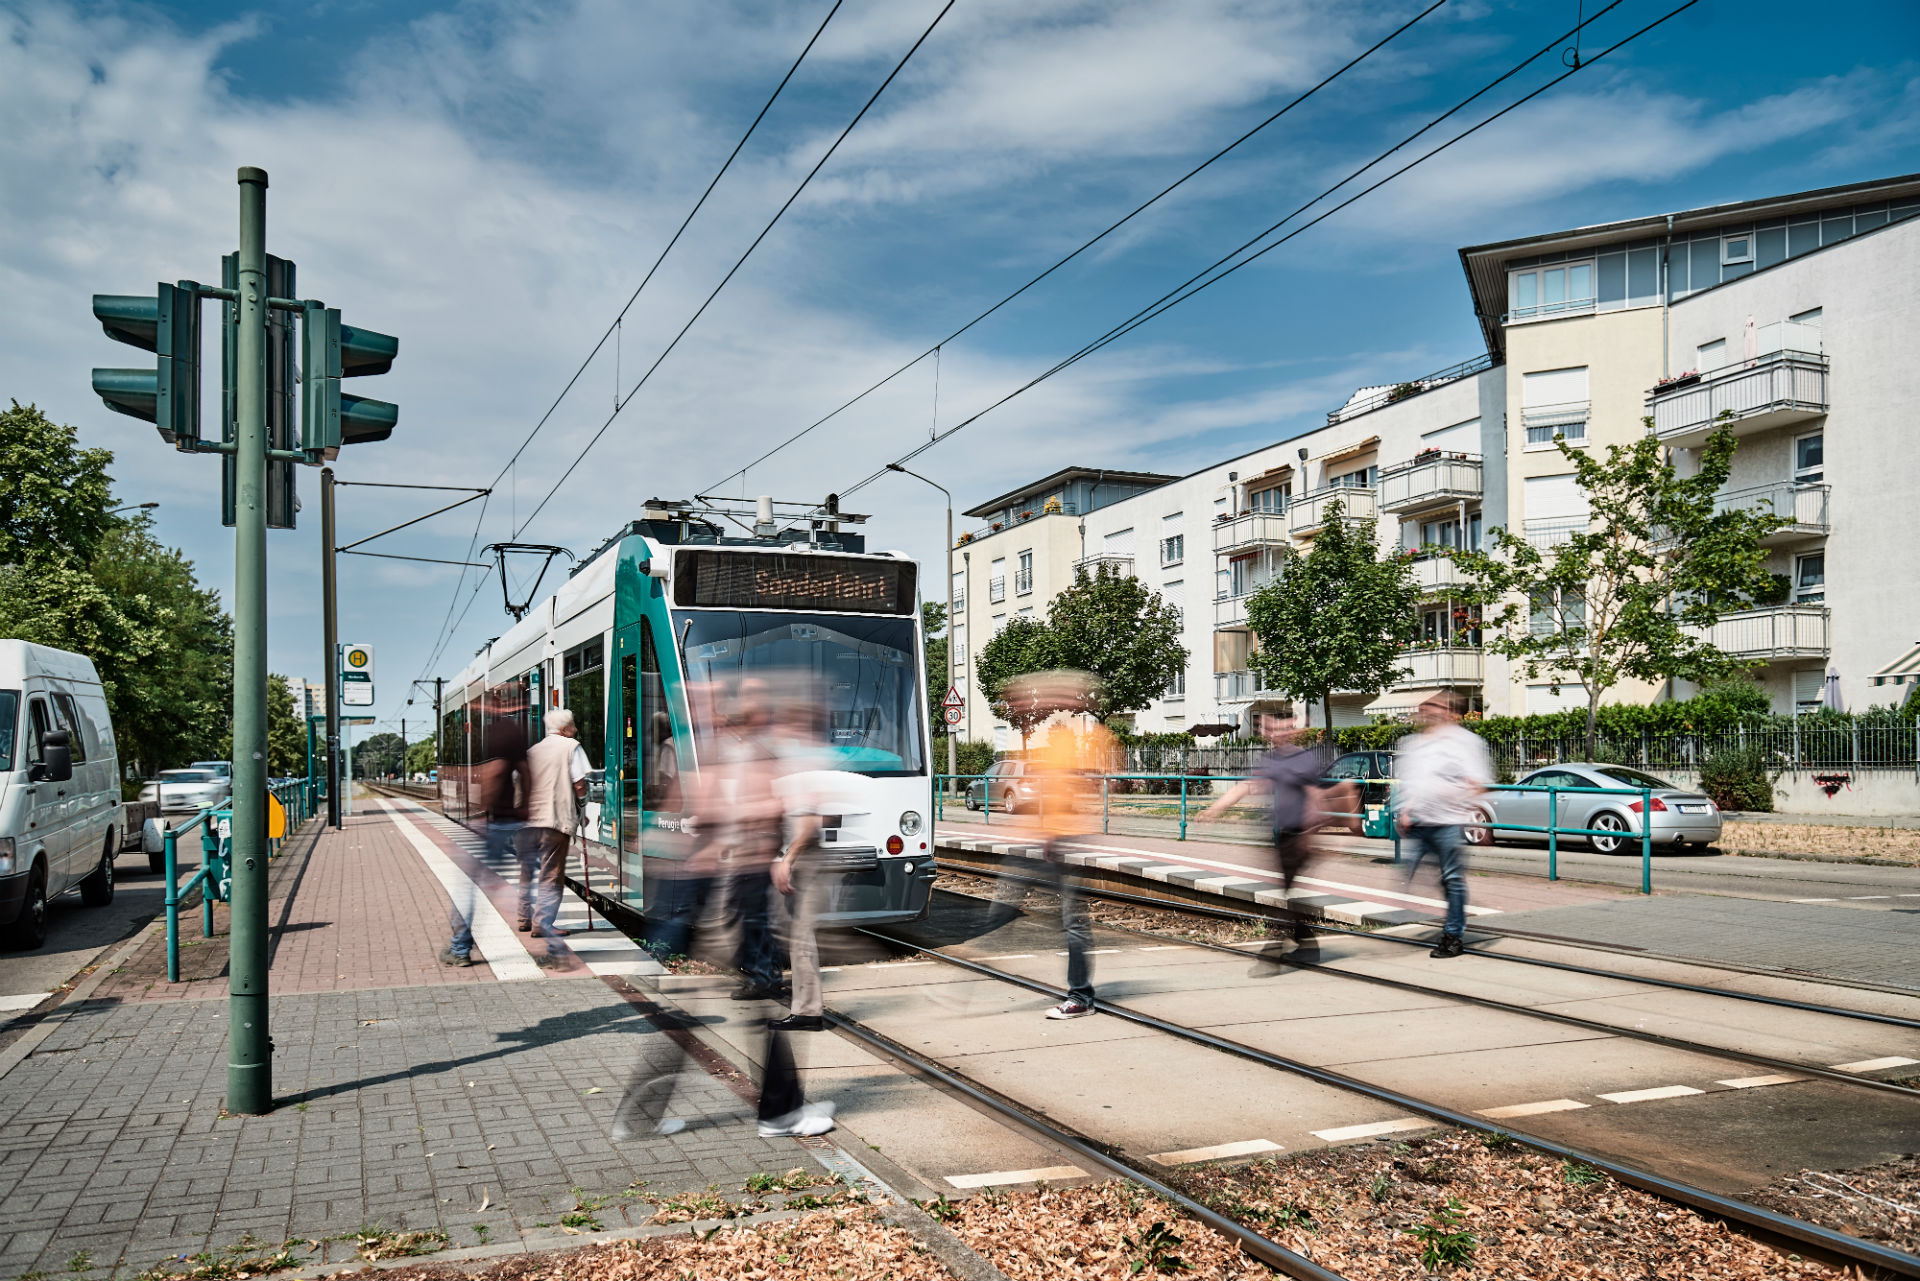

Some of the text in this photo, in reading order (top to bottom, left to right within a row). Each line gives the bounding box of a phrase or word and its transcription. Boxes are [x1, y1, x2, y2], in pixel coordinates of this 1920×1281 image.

[755, 570, 887, 600] Sonderfahrt
[353, 653, 363, 665] H
[947, 711, 960, 721] 30
